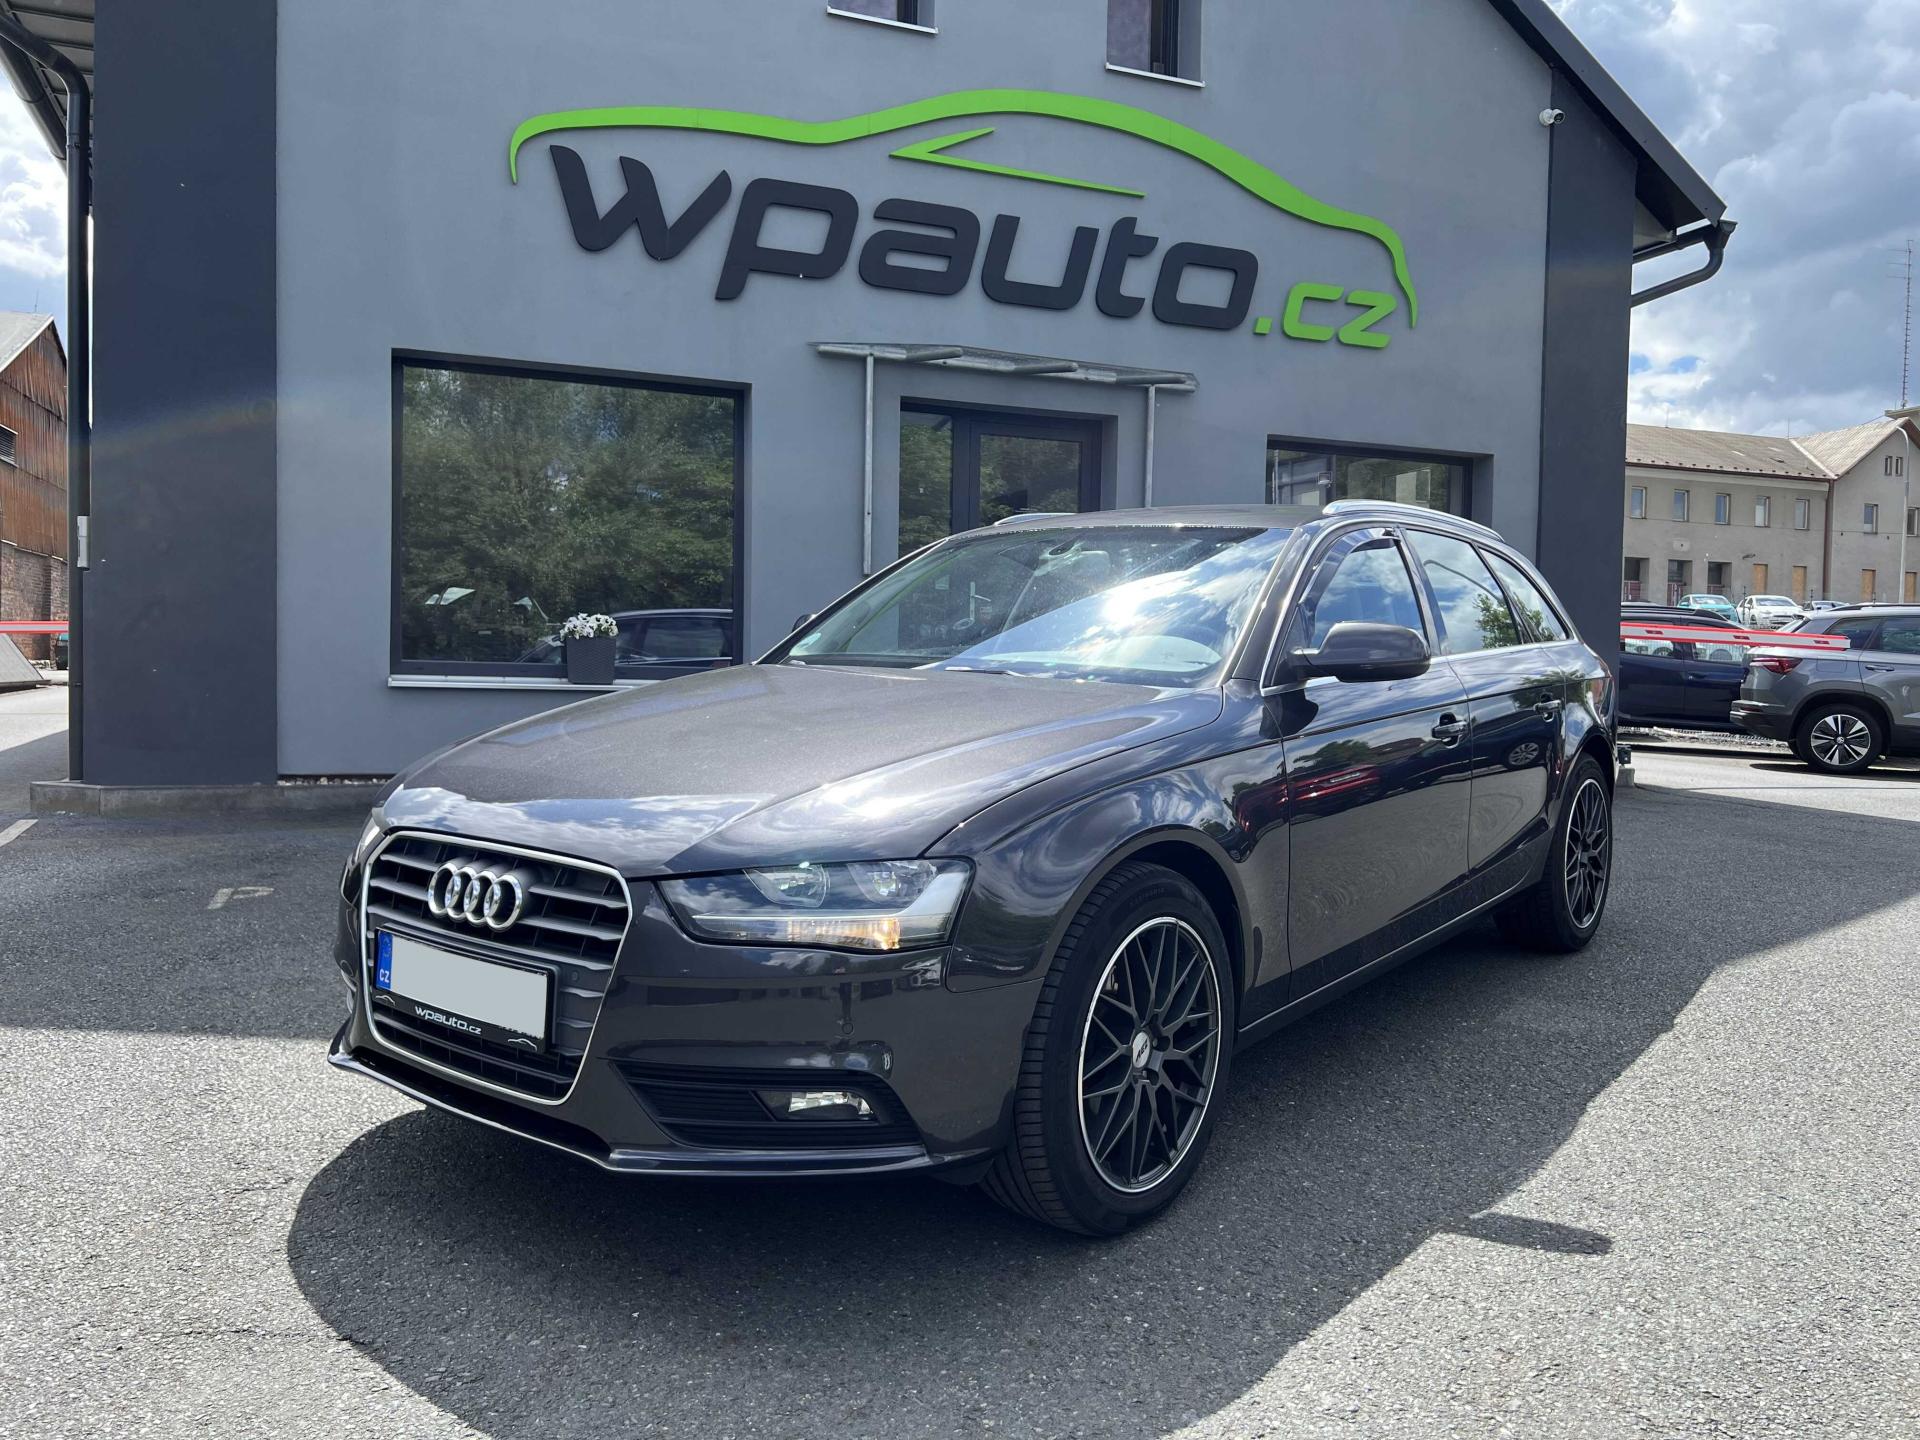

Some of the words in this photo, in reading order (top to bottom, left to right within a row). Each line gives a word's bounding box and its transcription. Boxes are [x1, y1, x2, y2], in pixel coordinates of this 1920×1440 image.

[549, 144, 1397, 349] wpauto.cz
[379, 968, 390, 983] CZ
[415, 1005, 482, 1035] wpauto.cz
